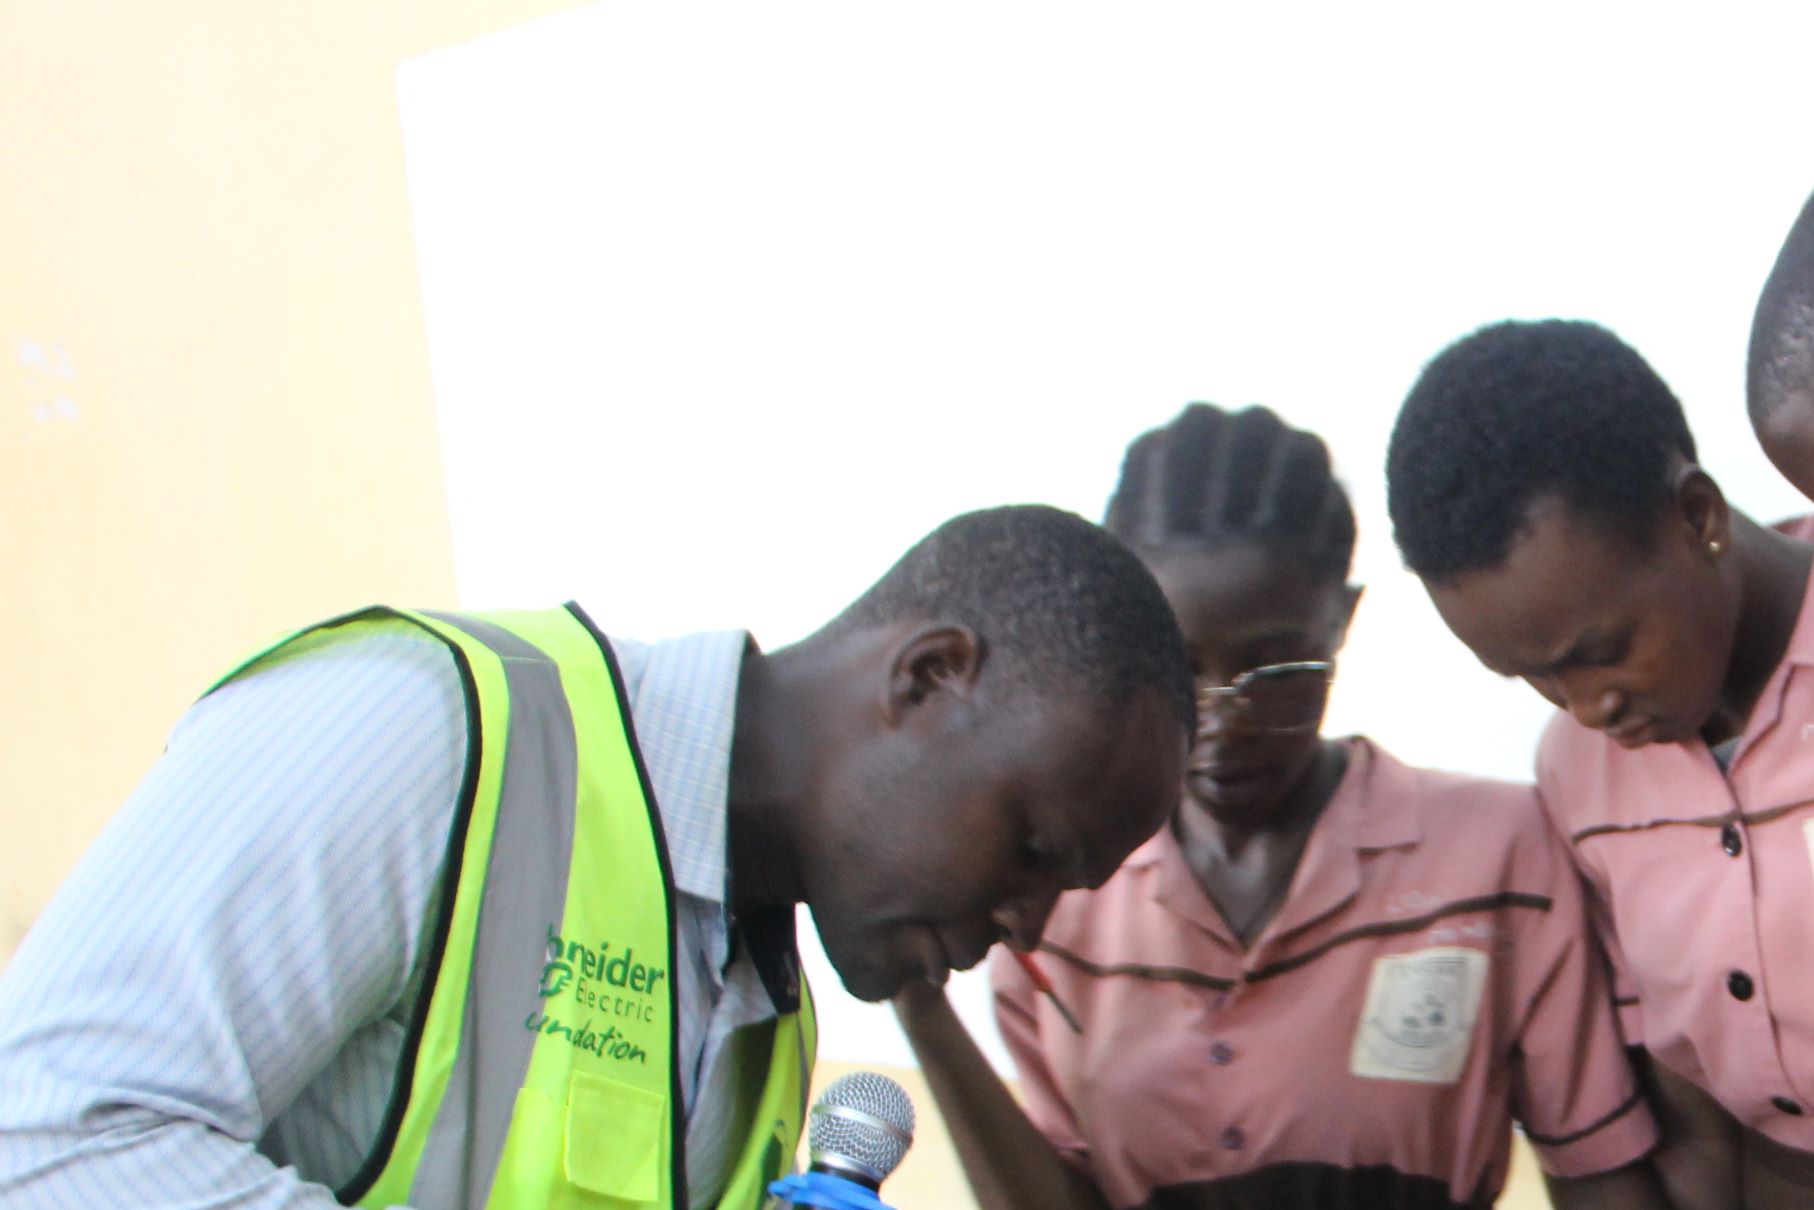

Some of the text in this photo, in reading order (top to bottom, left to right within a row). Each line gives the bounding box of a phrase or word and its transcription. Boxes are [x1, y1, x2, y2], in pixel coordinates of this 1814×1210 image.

[547, 923, 664, 995] hneider
[576, 977, 654, 1022] Electric
[524, 1011, 646, 1063] undation
